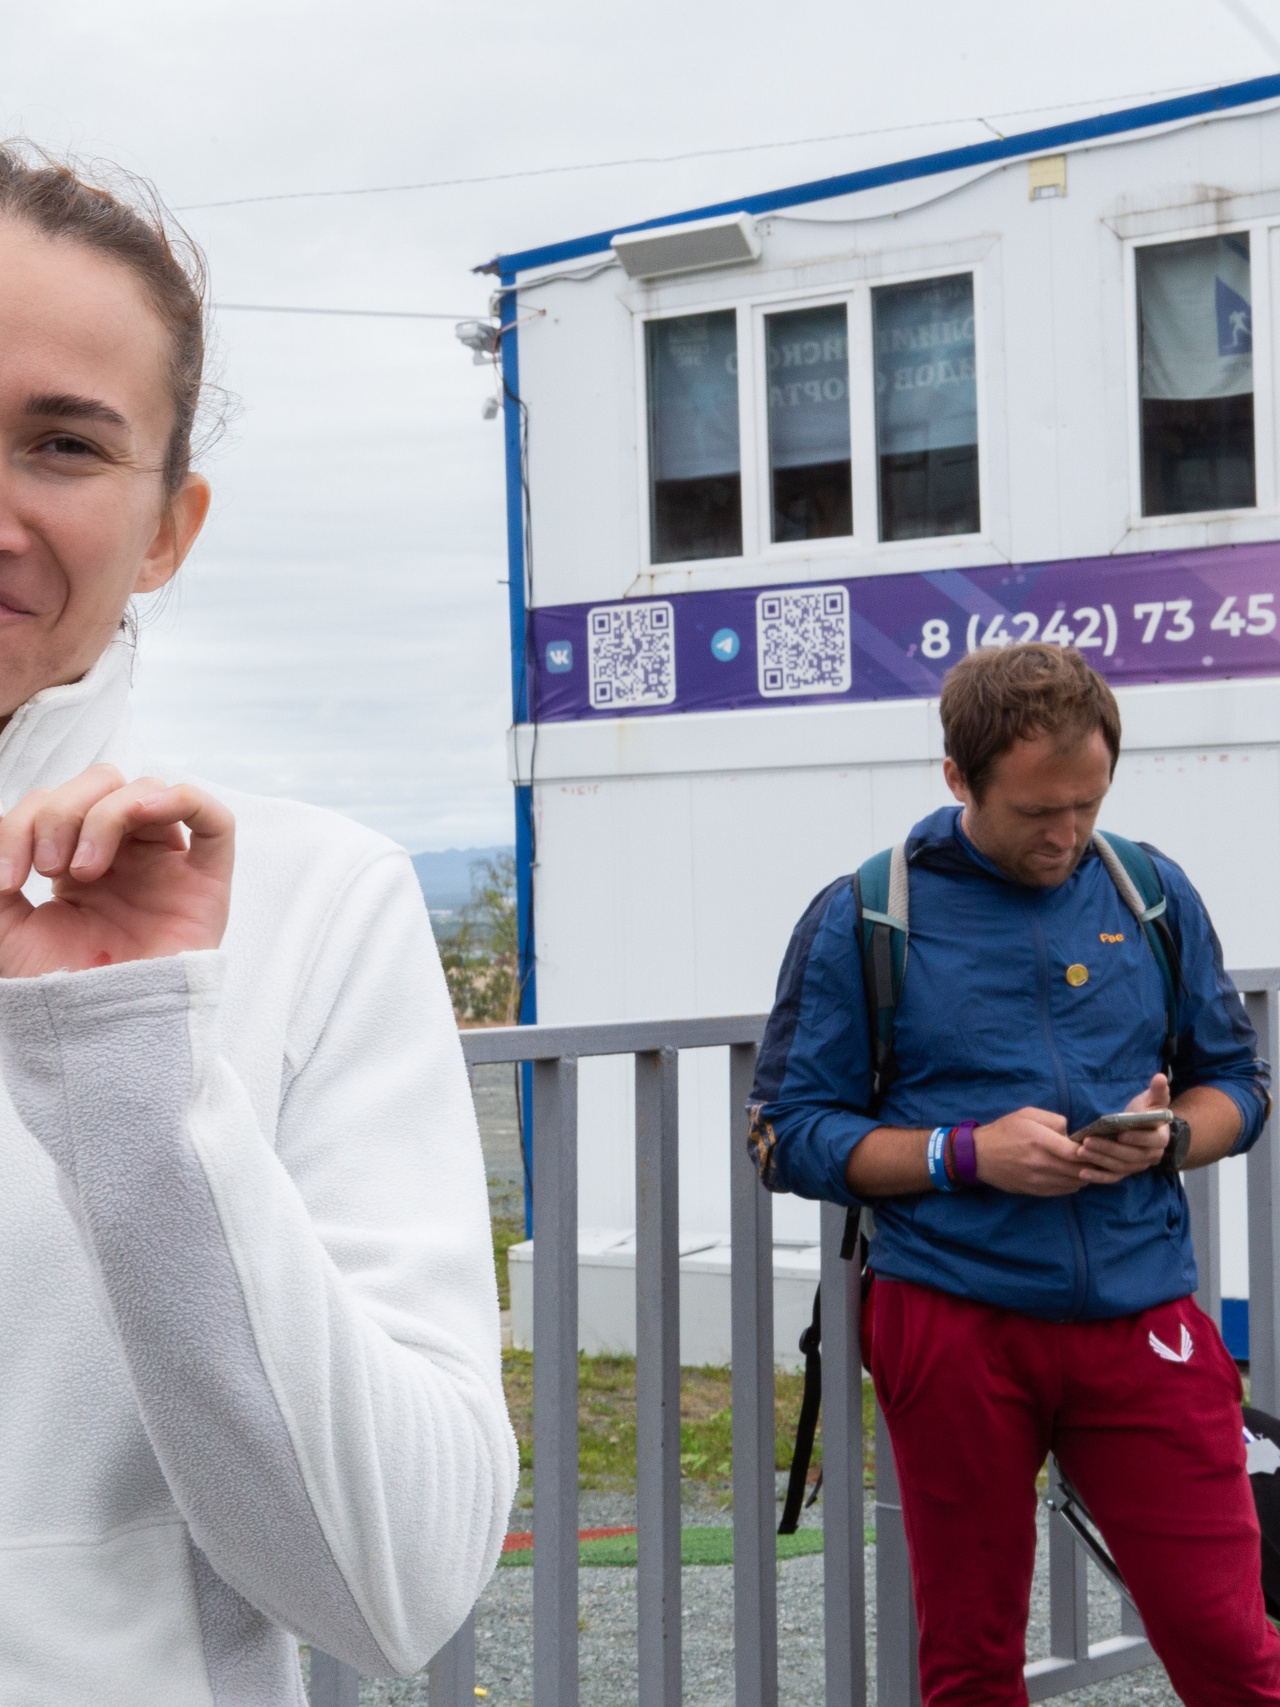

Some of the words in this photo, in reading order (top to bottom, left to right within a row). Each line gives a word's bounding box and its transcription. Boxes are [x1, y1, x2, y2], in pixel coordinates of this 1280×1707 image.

[920, 618, 950, 659] 8
[966, 603, 1118, 656] (4242)
[1132, 599, 1195, 644] 73
[1209, 593, 1278, 637] 45
